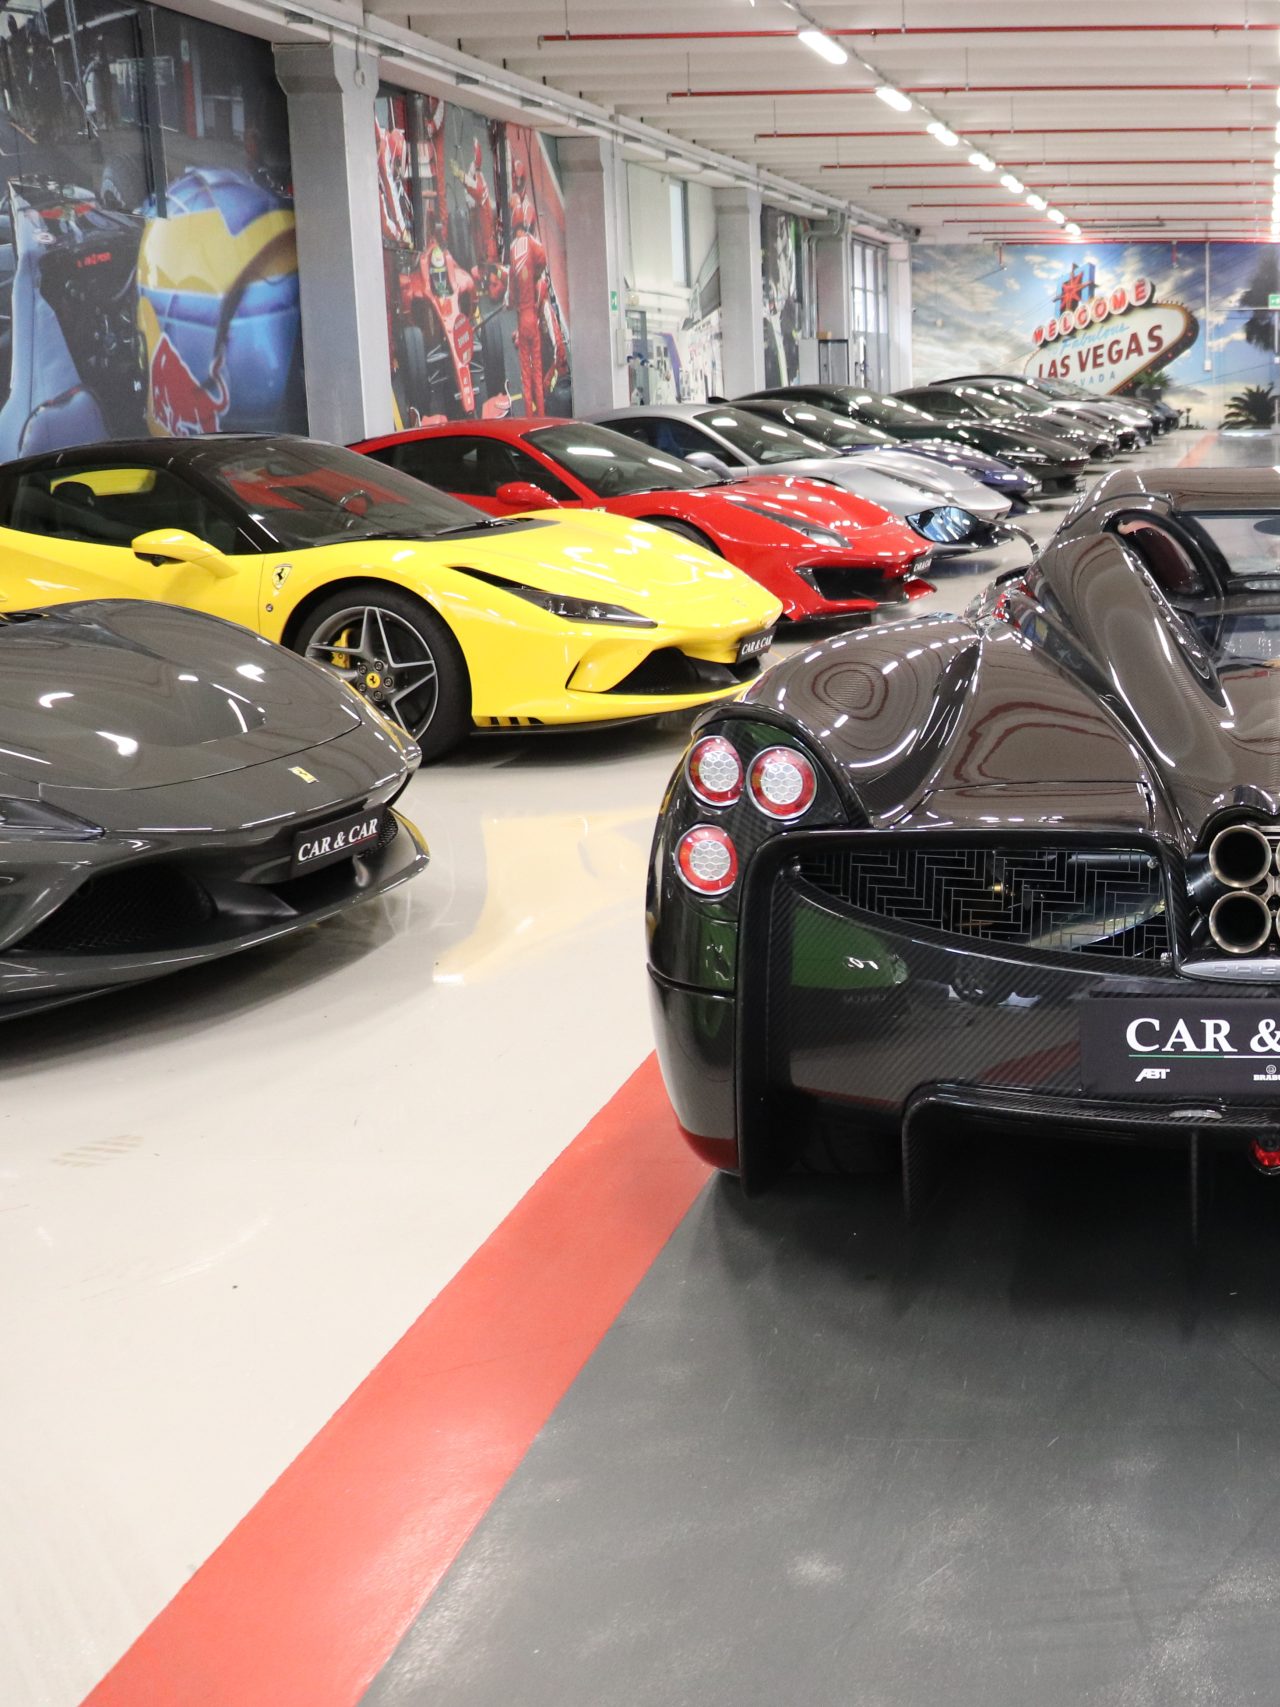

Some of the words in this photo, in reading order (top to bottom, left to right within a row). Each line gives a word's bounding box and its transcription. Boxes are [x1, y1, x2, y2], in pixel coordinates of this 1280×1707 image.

[1033, 277, 1147, 345] WELCOME
[1038, 355, 1071, 379] LAS
[1077, 325, 1163, 372] VEGAS
[298, 837, 331, 861] CAR
[333, 831, 346, 849] &
[349, 818, 378, 842] CAR
[1126, 1018, 1238, 1053] CAR
[1135, 1068, 1171, 1083] ABT
